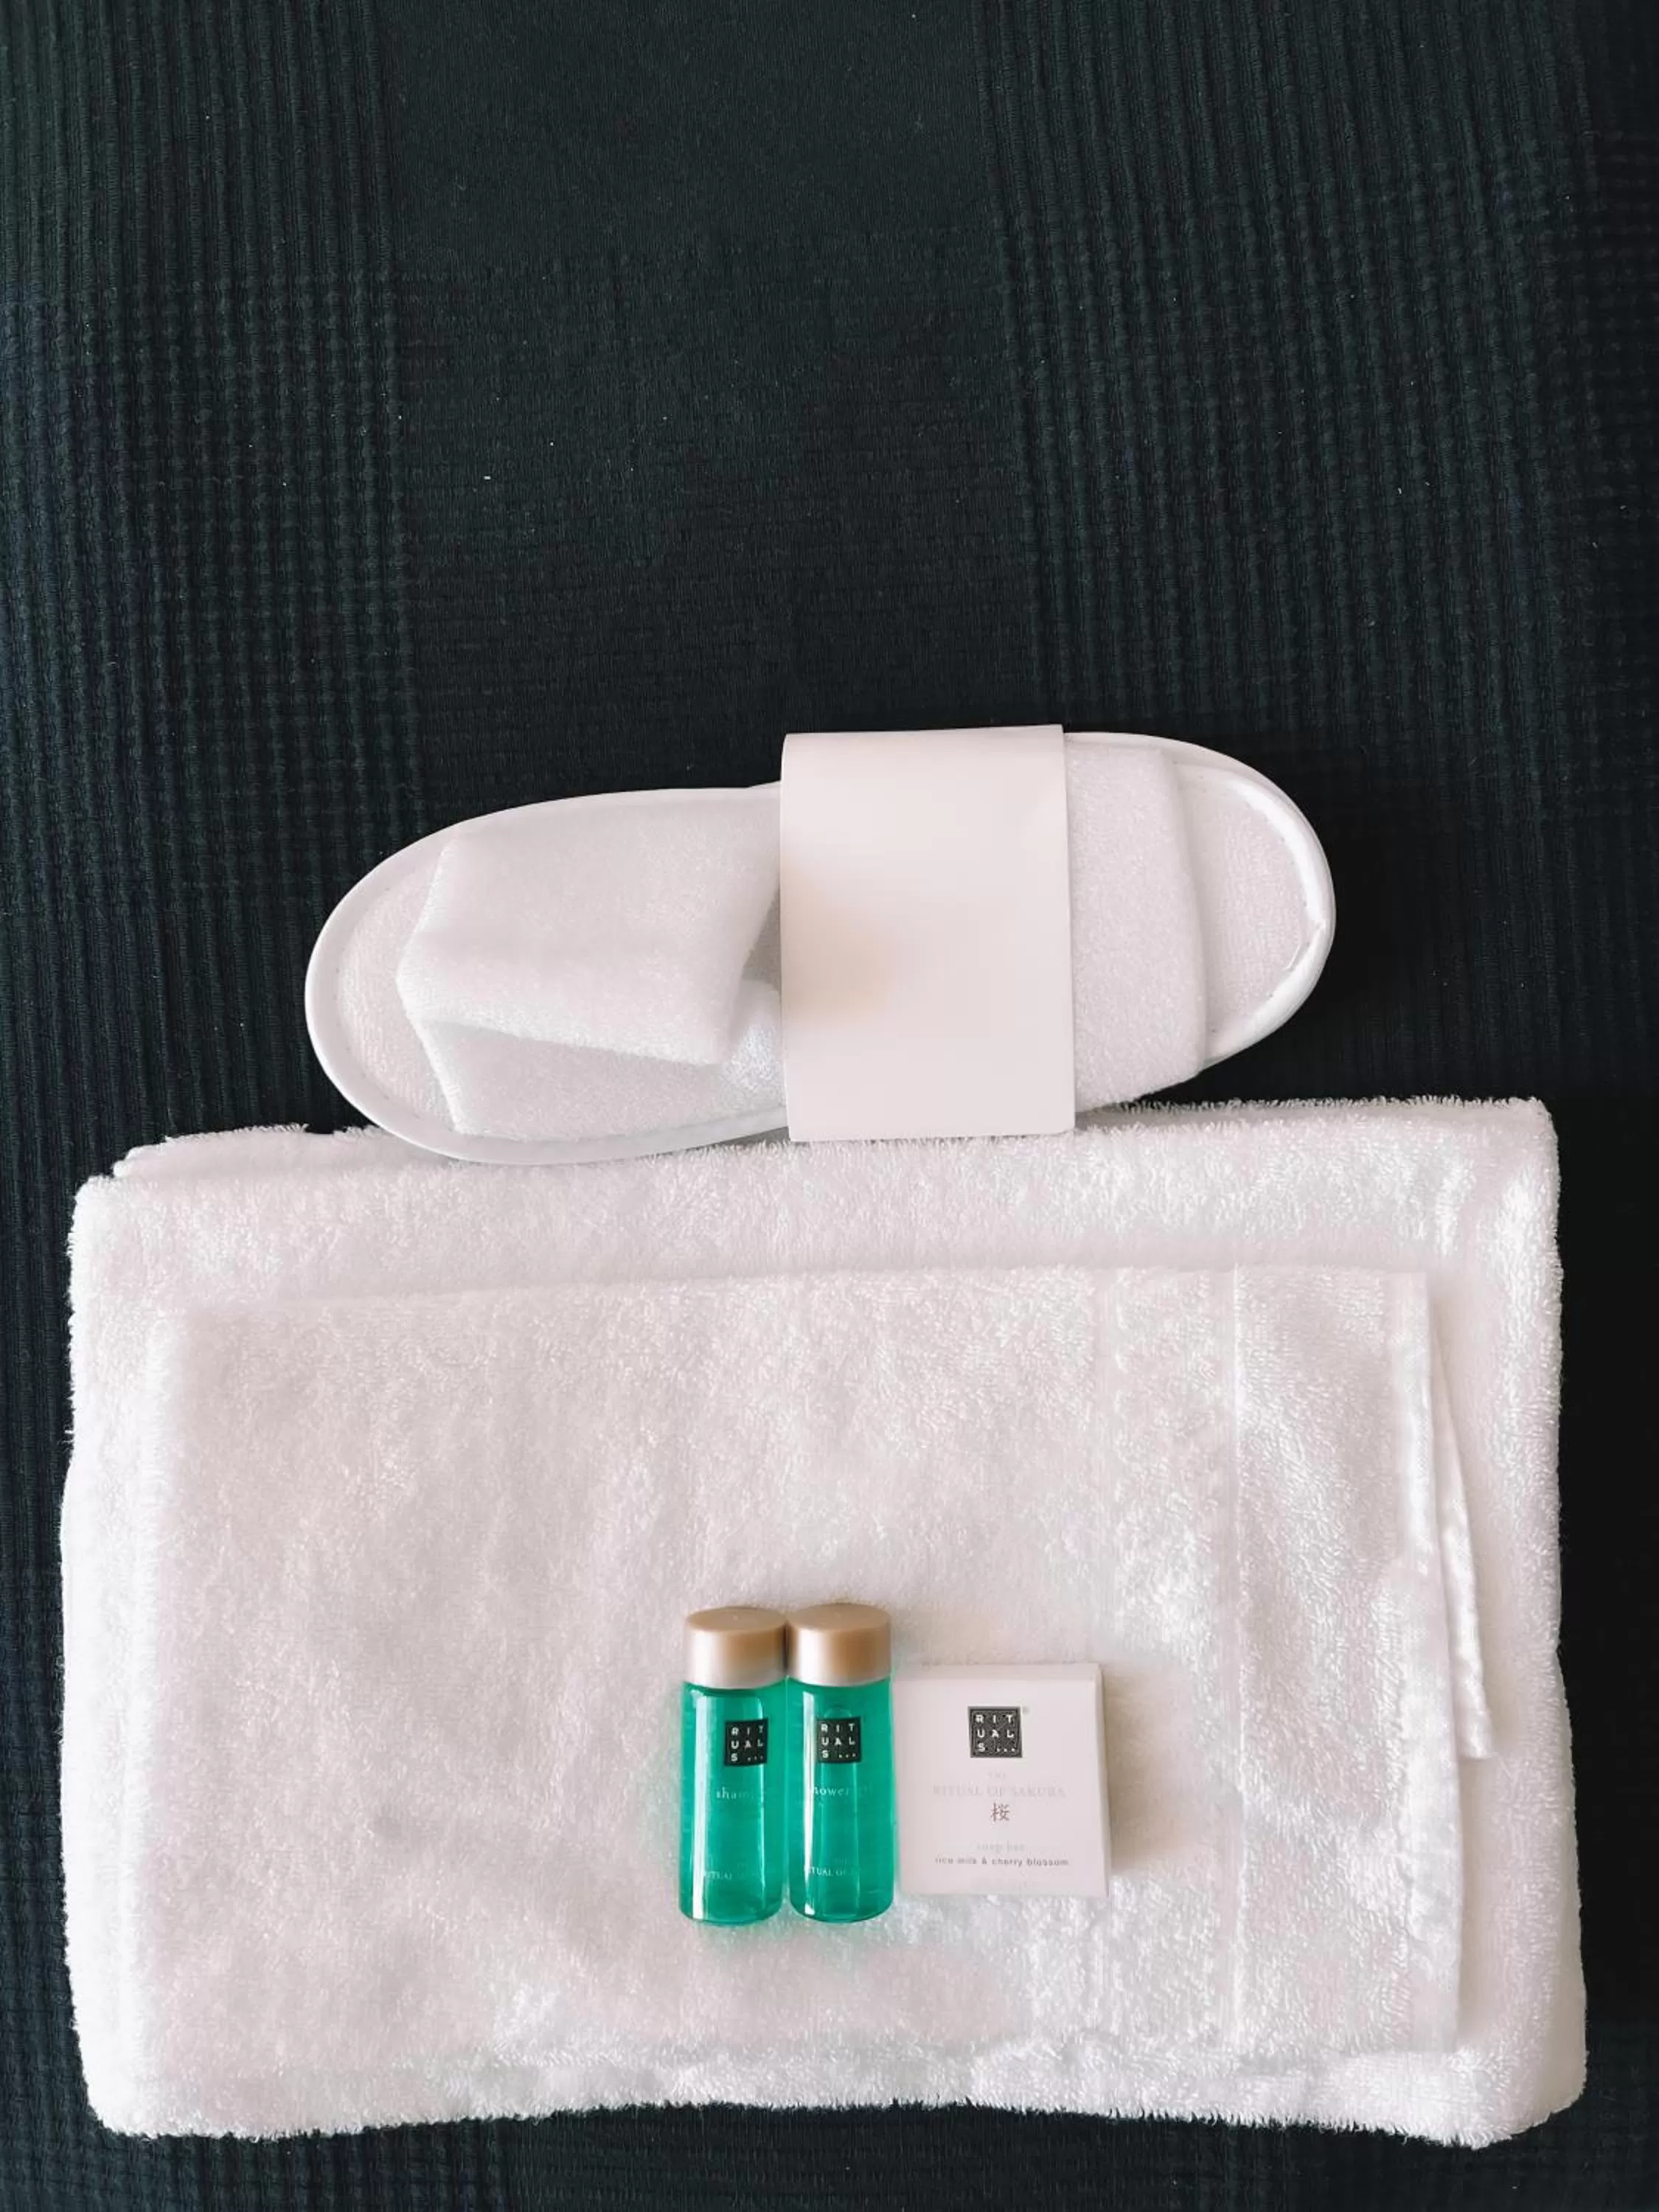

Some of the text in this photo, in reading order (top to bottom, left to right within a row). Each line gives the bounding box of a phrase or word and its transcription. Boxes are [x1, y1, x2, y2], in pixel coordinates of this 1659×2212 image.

[932, 1785, 1067, 1798] RITUAL OF SAKURA
[990, 1801, 1010, 1823] 桜
[934, 1856, 954, 1865] rice
[981, 1855, 988, 1865] &
[992, 1857, 1023, 1867] cherry
[1026, 1857, 1069, 1867] blossom
